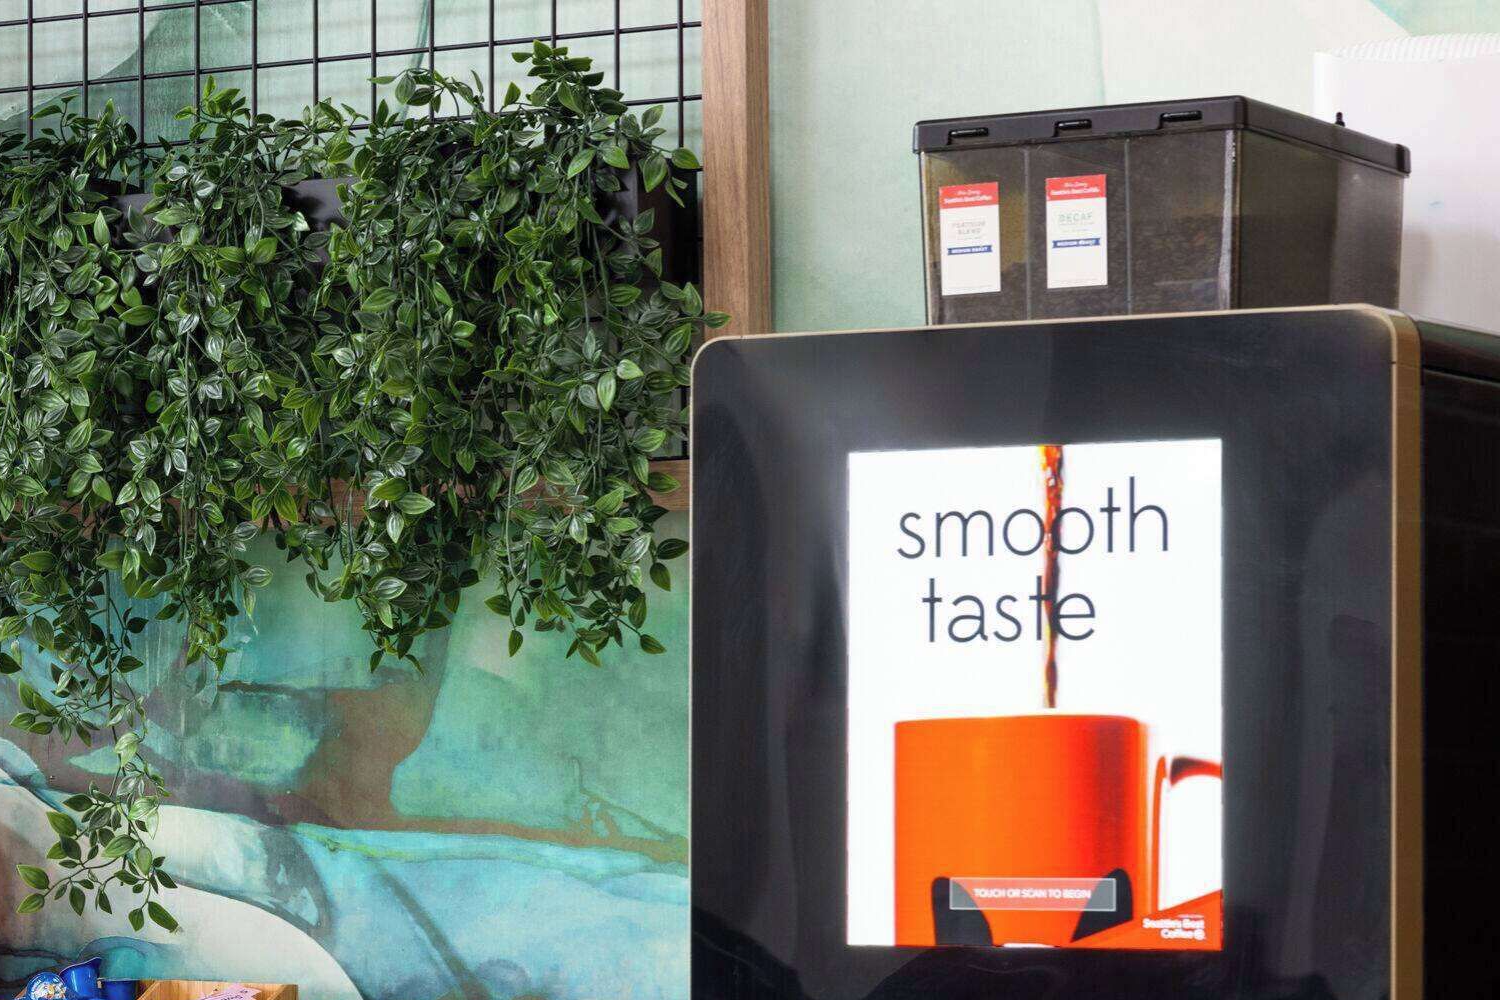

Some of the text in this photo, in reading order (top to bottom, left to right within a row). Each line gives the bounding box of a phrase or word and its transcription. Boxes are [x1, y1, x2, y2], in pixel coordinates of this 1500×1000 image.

[1058, 211, 1093, 222] DECAF
[897, 476, 1169, 560] smooth
[922, 575, 1096, 643] taste
[973, 888, 1092, 899] TOUCH OR SCAN TO BEGIN
